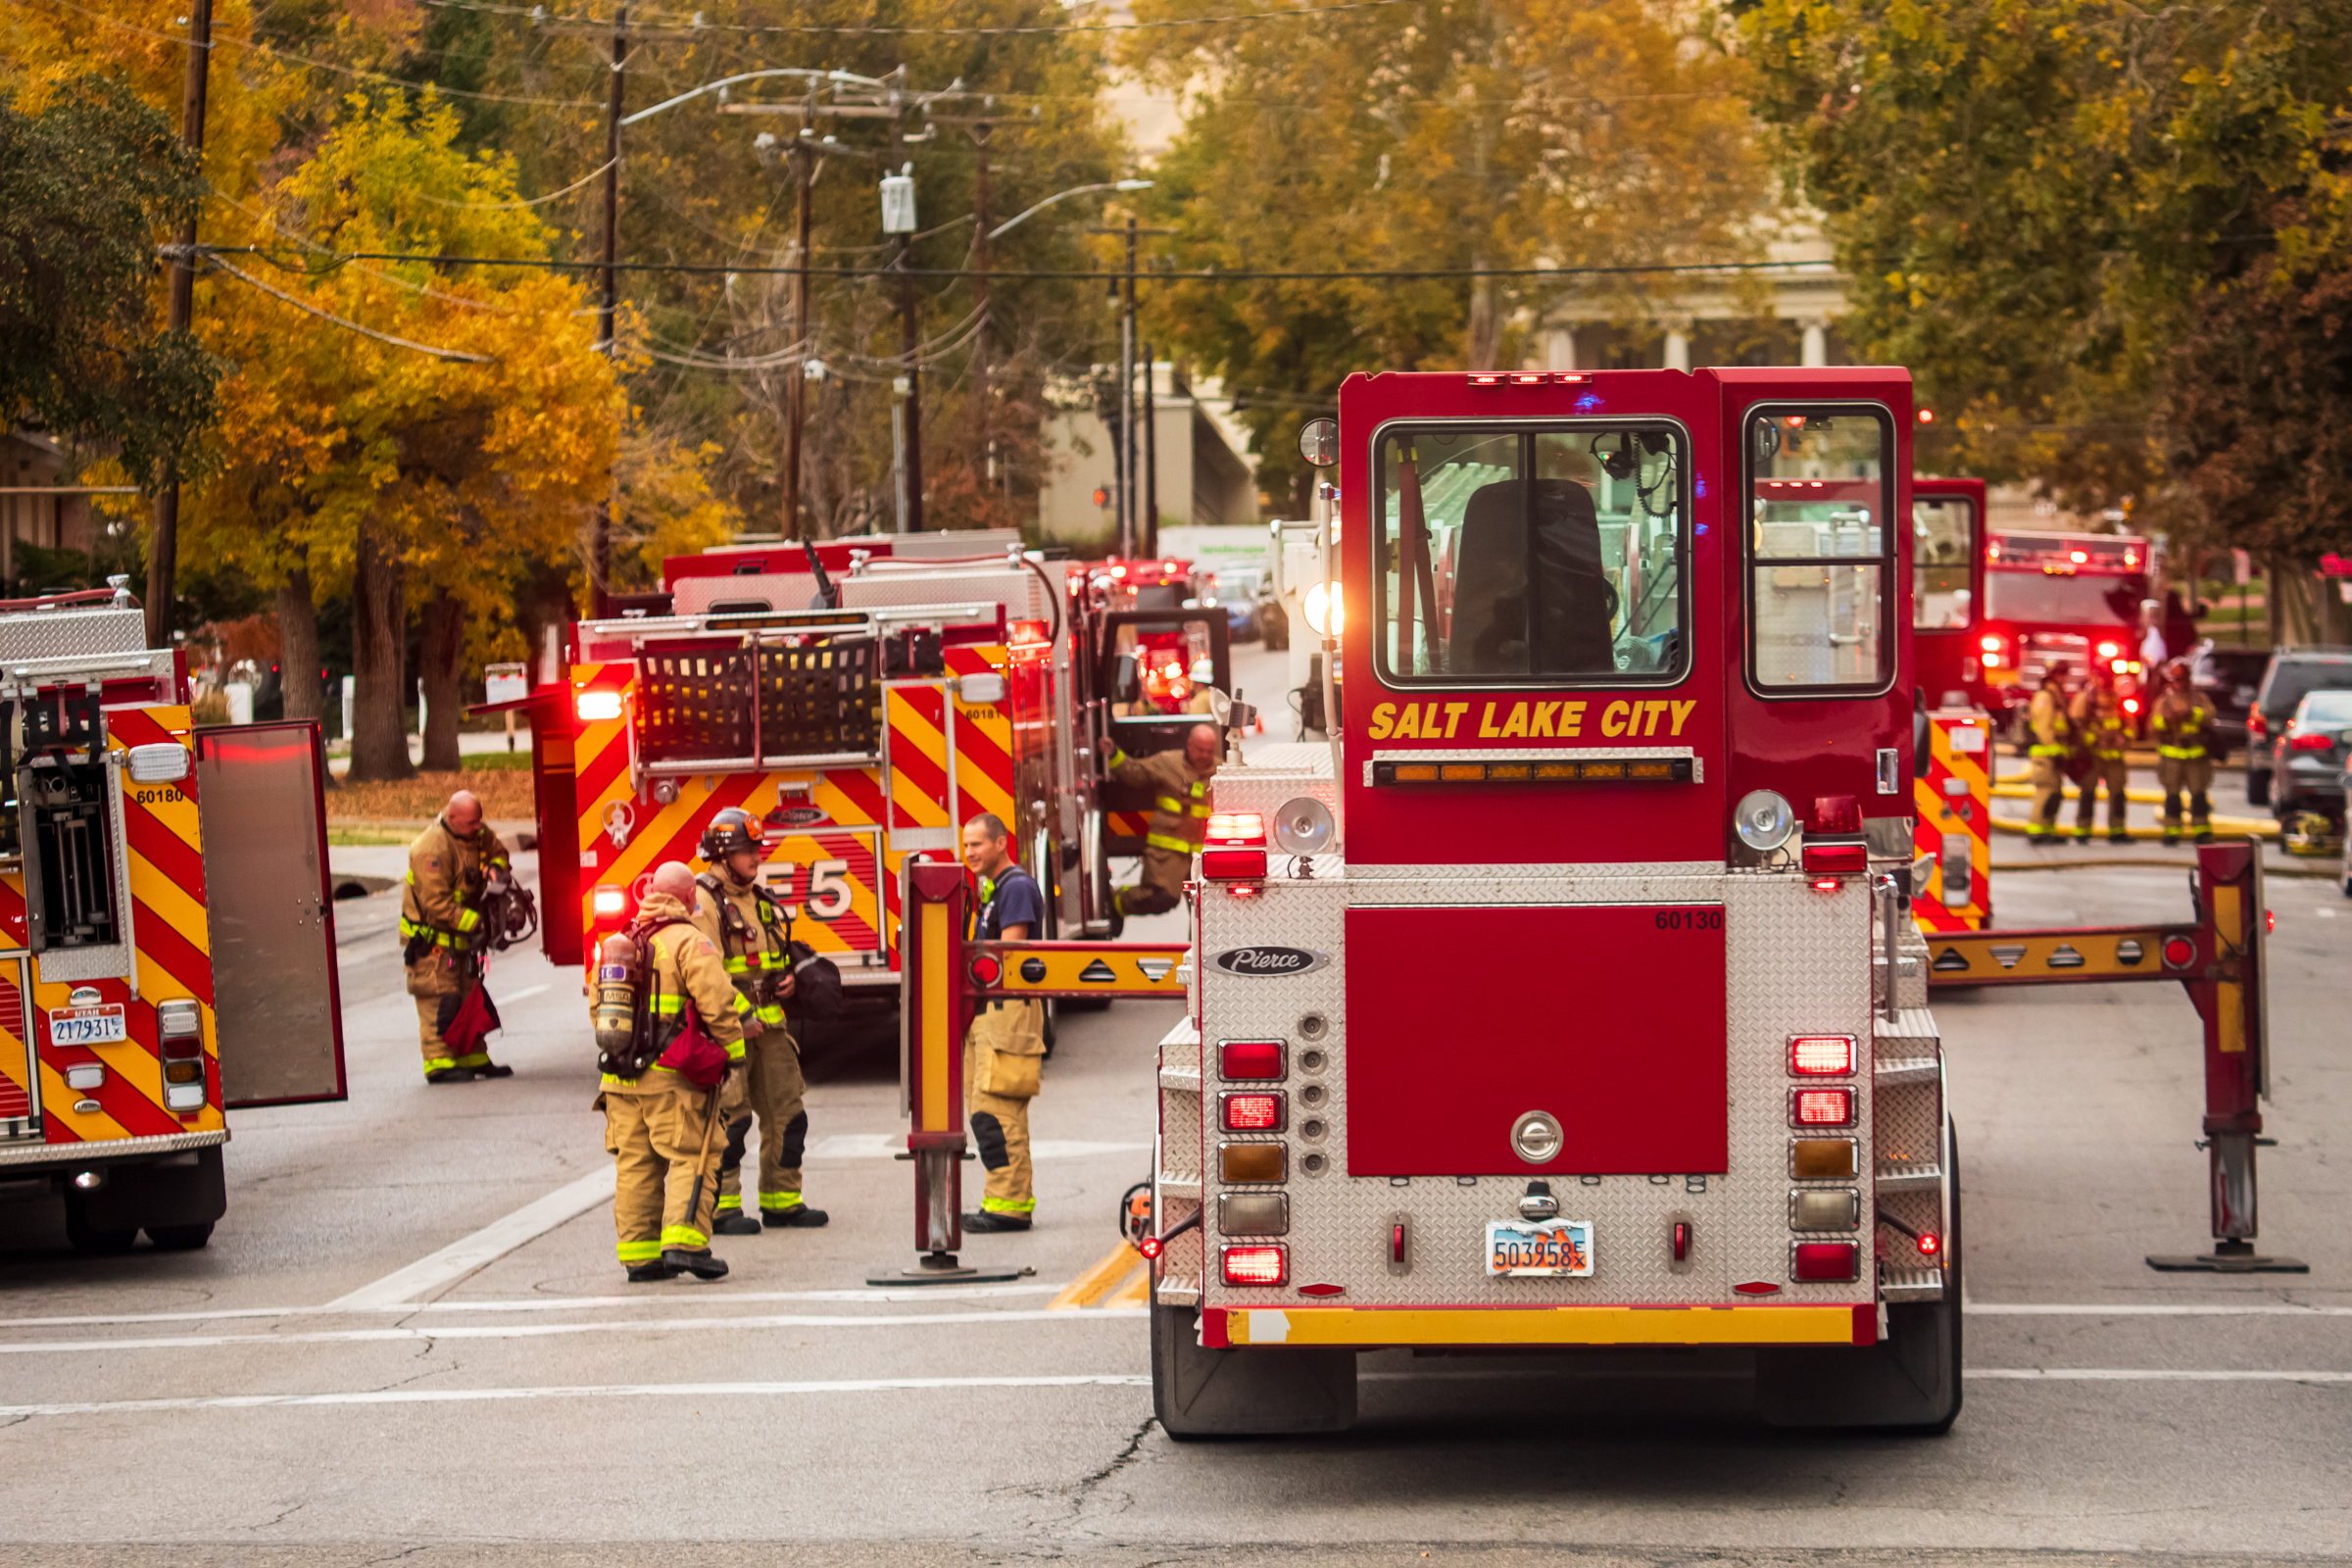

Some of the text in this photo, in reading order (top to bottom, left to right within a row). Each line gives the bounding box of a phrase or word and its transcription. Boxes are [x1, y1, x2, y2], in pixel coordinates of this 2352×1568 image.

[965, 709, 1001, 720] 60181
[1368, 700, 1697, 739] SALT LAKE CITY
[136, 788, 184, 805] 60180
[753, 858, 853, 919] E5
[1655, 910, 1722, 930] 60130
[1230, 949, 1300, 972] Pierce
[74, 1007, 99, 1018] UTAH
[56, 1018, 110, 1040] 217931
[1494, 1242, 1571, 1267] 503958
